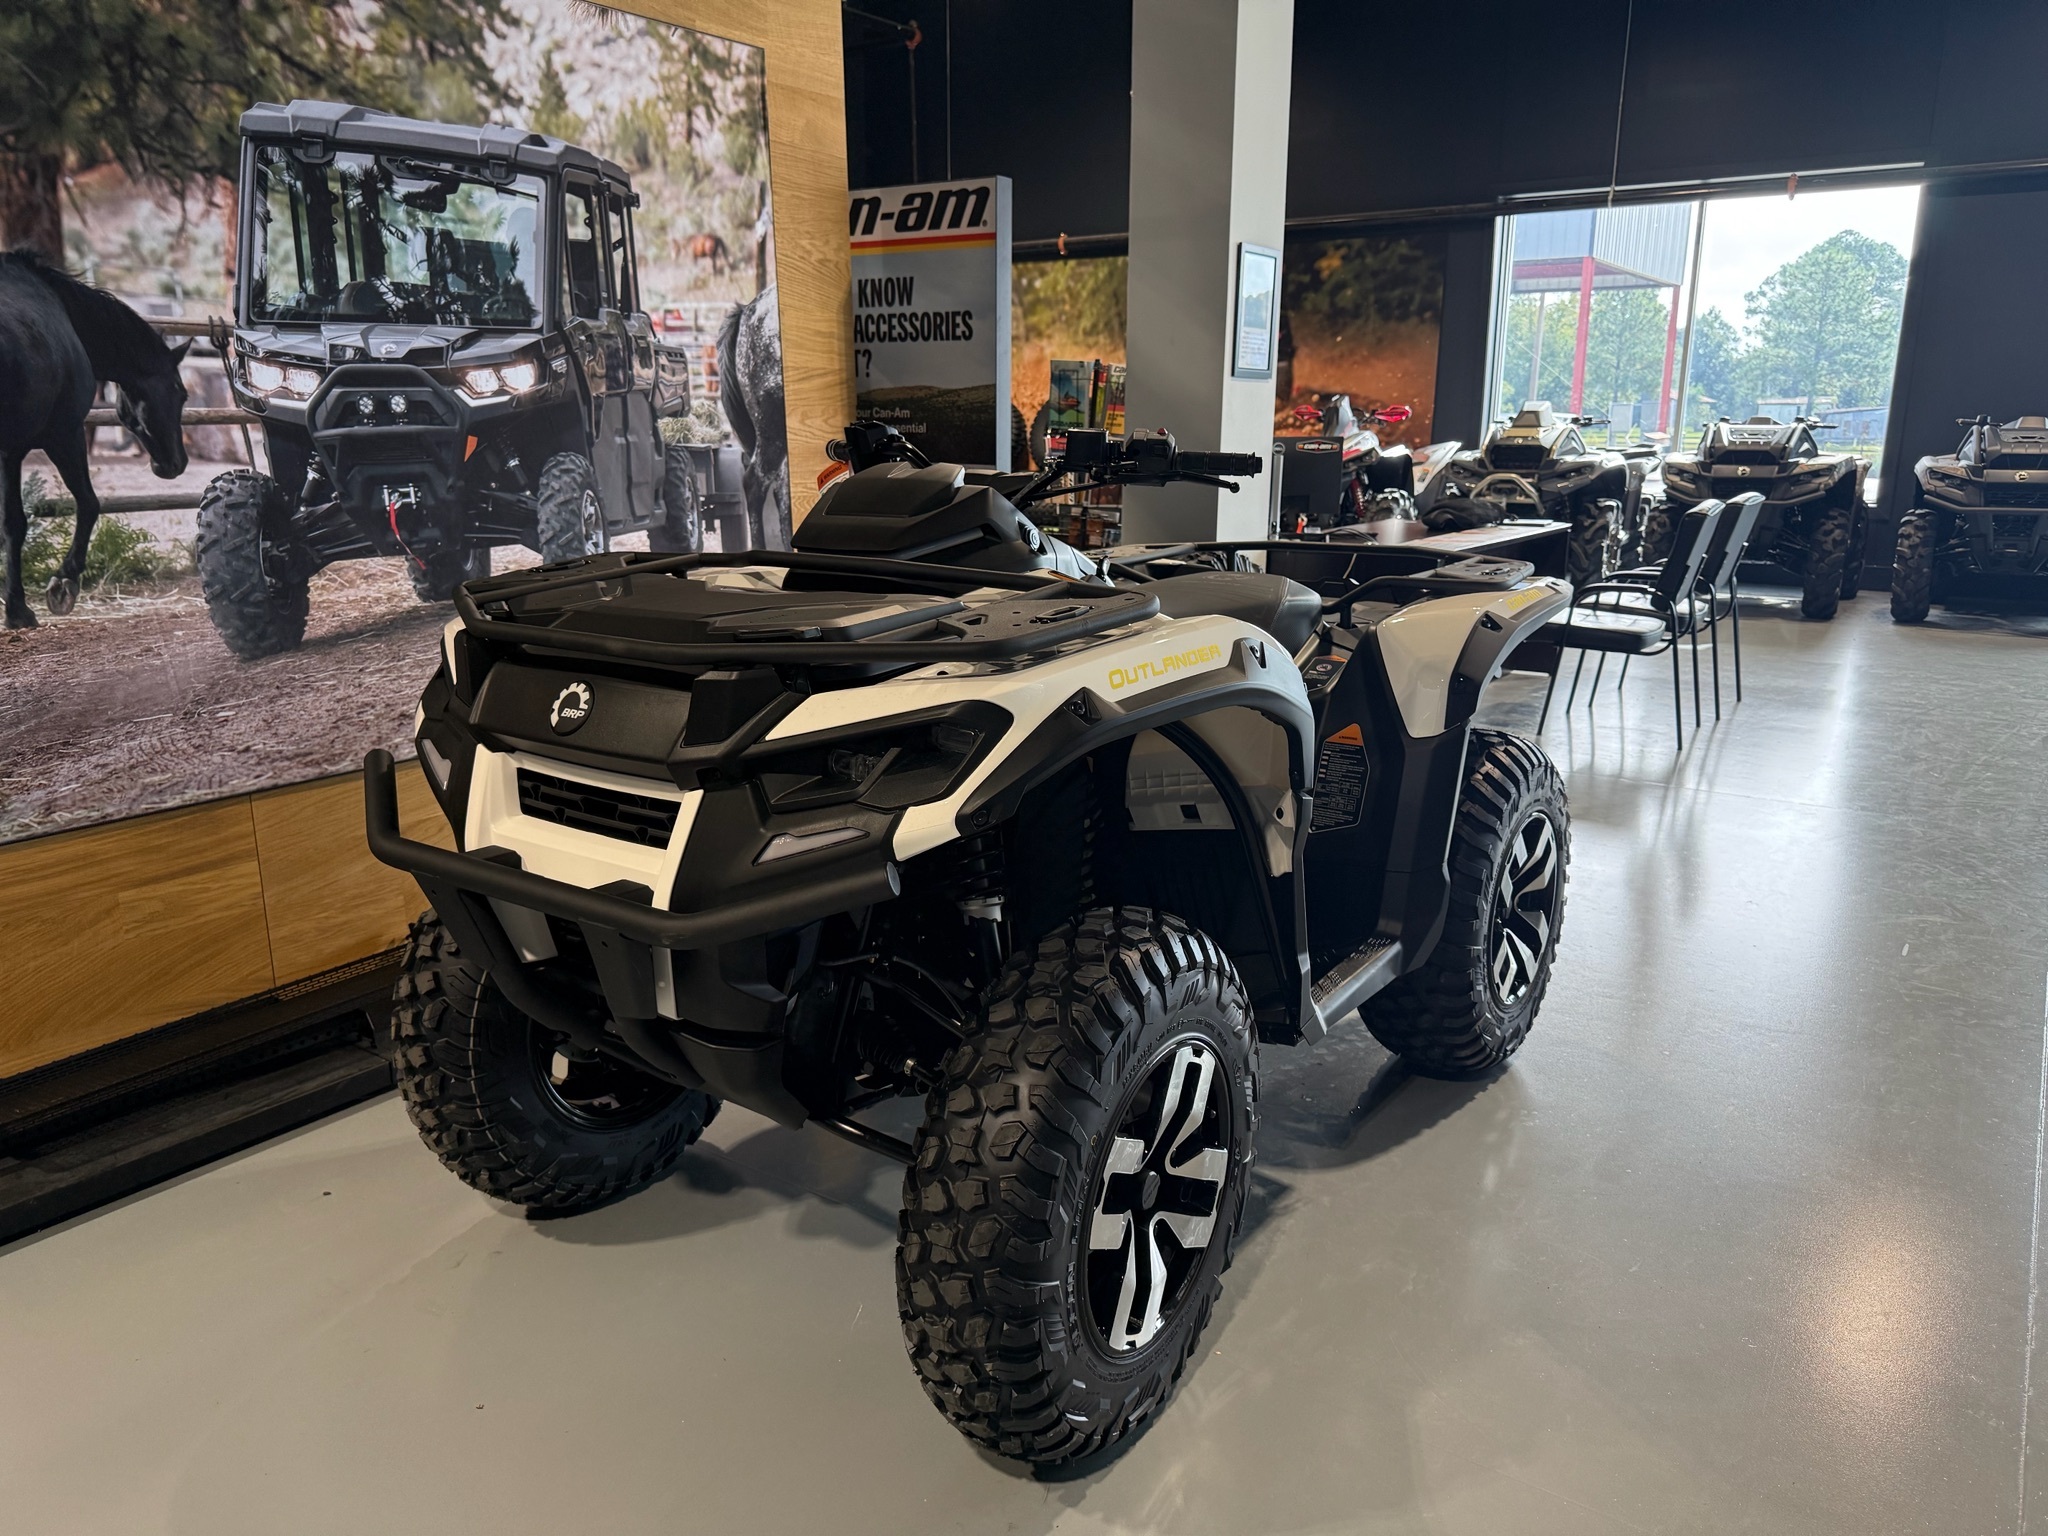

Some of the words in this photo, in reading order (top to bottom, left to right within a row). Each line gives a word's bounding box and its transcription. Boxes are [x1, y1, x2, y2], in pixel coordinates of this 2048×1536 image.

[857, 276, 914, 308] KNOW
[853, 310, 973, 343] ACCESSORIES
[872, 407, 911, 419] Can-Am
[1505, 588, 1543, 611] can-am
[1108, 644, 1223, 690] OUTLANDER
[560, 707, 586, 719] BRP
